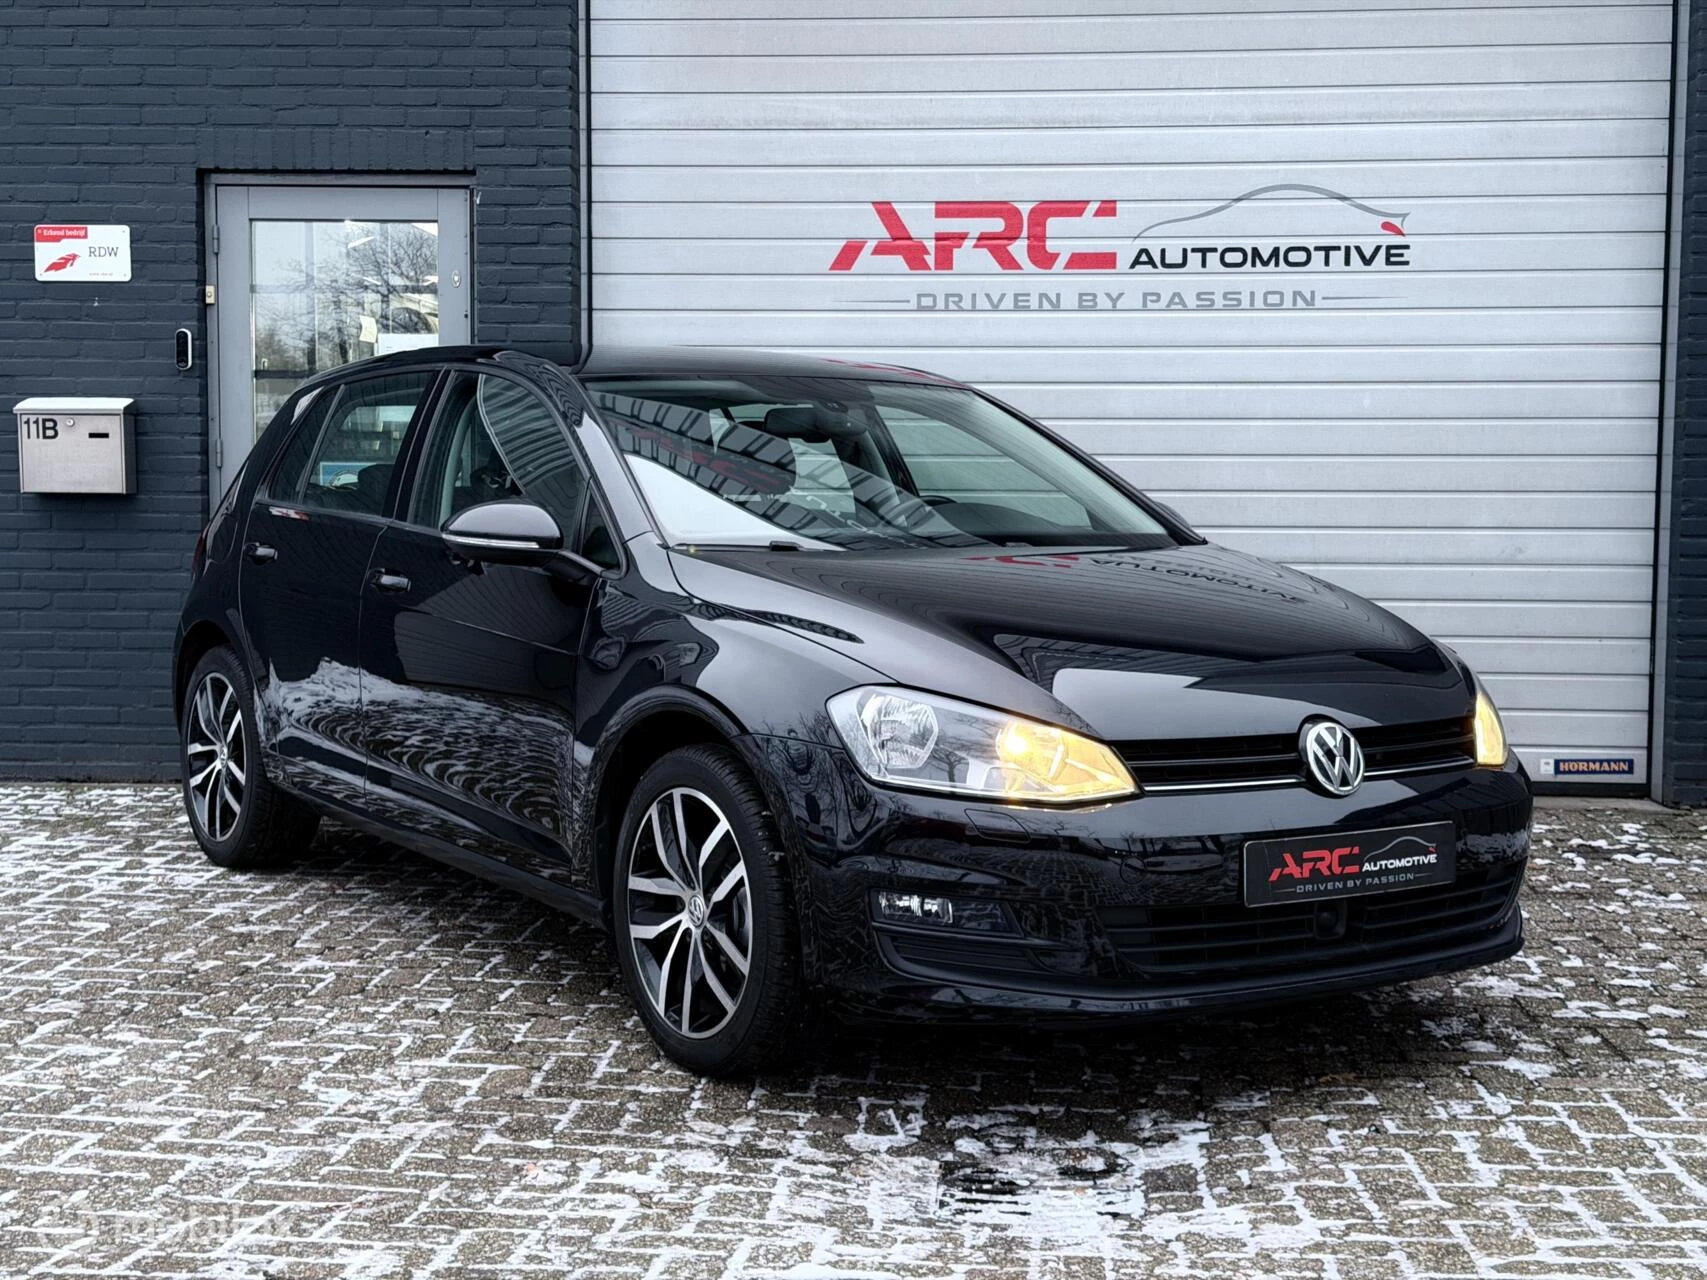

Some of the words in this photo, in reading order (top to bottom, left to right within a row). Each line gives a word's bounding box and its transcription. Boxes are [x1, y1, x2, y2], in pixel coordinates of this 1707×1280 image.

[829, 200, 1117, 271] ARC
[1129, 244, 1410, 269] AUTOMOTIVE
[88, 246, 119, 258] RDW
[916, 292, 1062, 310] DRIVEN
[1077, 292, 1126, 310] BY
[1142, 290, 1316, 309] PASSION
[23, 417, 59, 440] 11B
[1269, 847, 1360, 881] ARC
[1362, 854, 1438, 873] AUTOMOTIVE
[1296, 880, 1343, 894] DRIVEN
[1347, 879, 1363, 888] BY
[1366, 872, 1415, 886] PASSION
